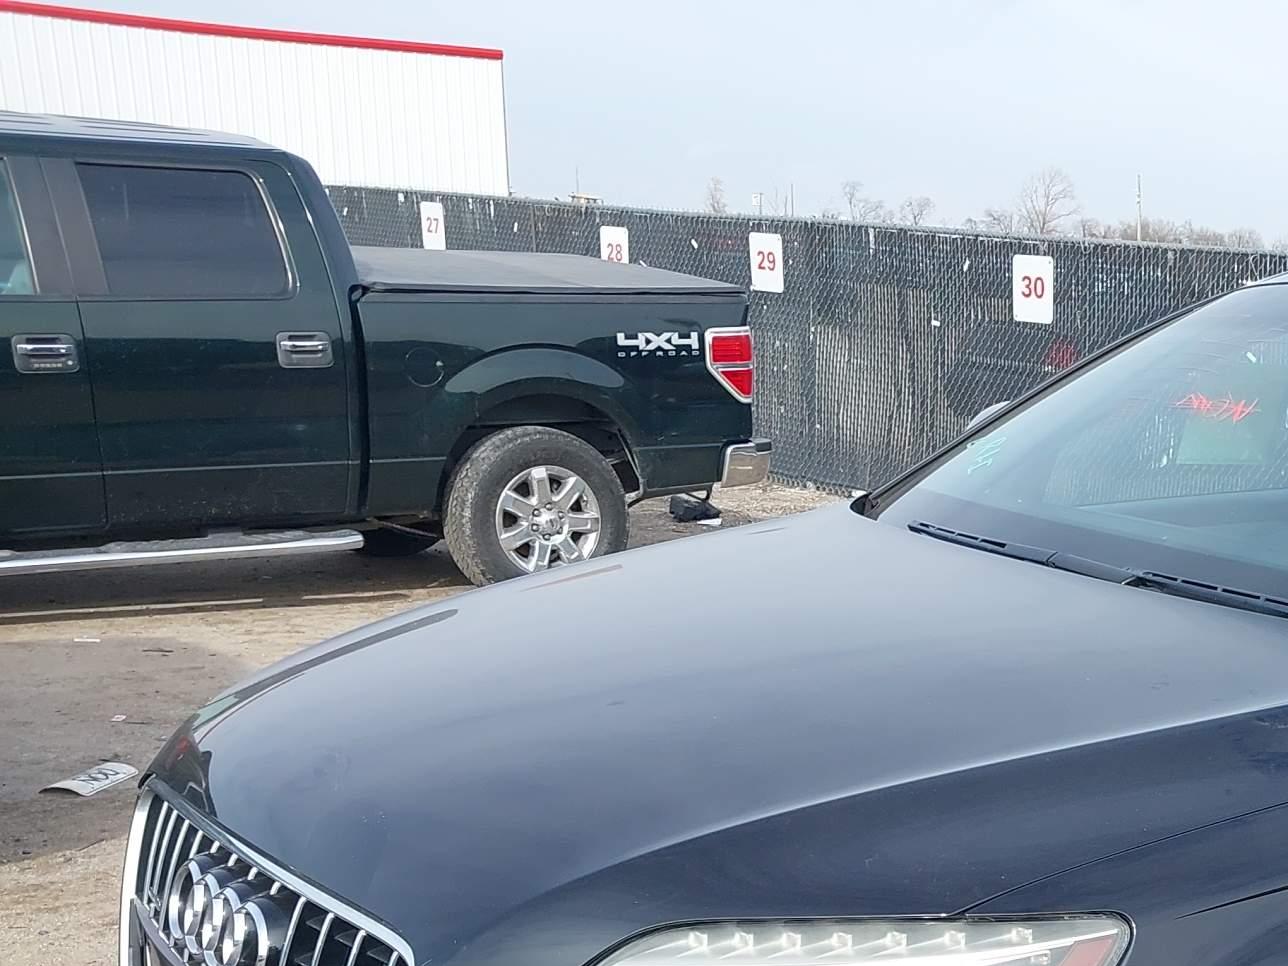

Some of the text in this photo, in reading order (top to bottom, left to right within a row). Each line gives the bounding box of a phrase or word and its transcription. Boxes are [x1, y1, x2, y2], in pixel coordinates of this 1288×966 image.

[426, 216, 440, 234] 27
[607, 243, 624, 263] 28
[757, 251, 776, 271] 29
[1021, 276, 1045, 299] 30
